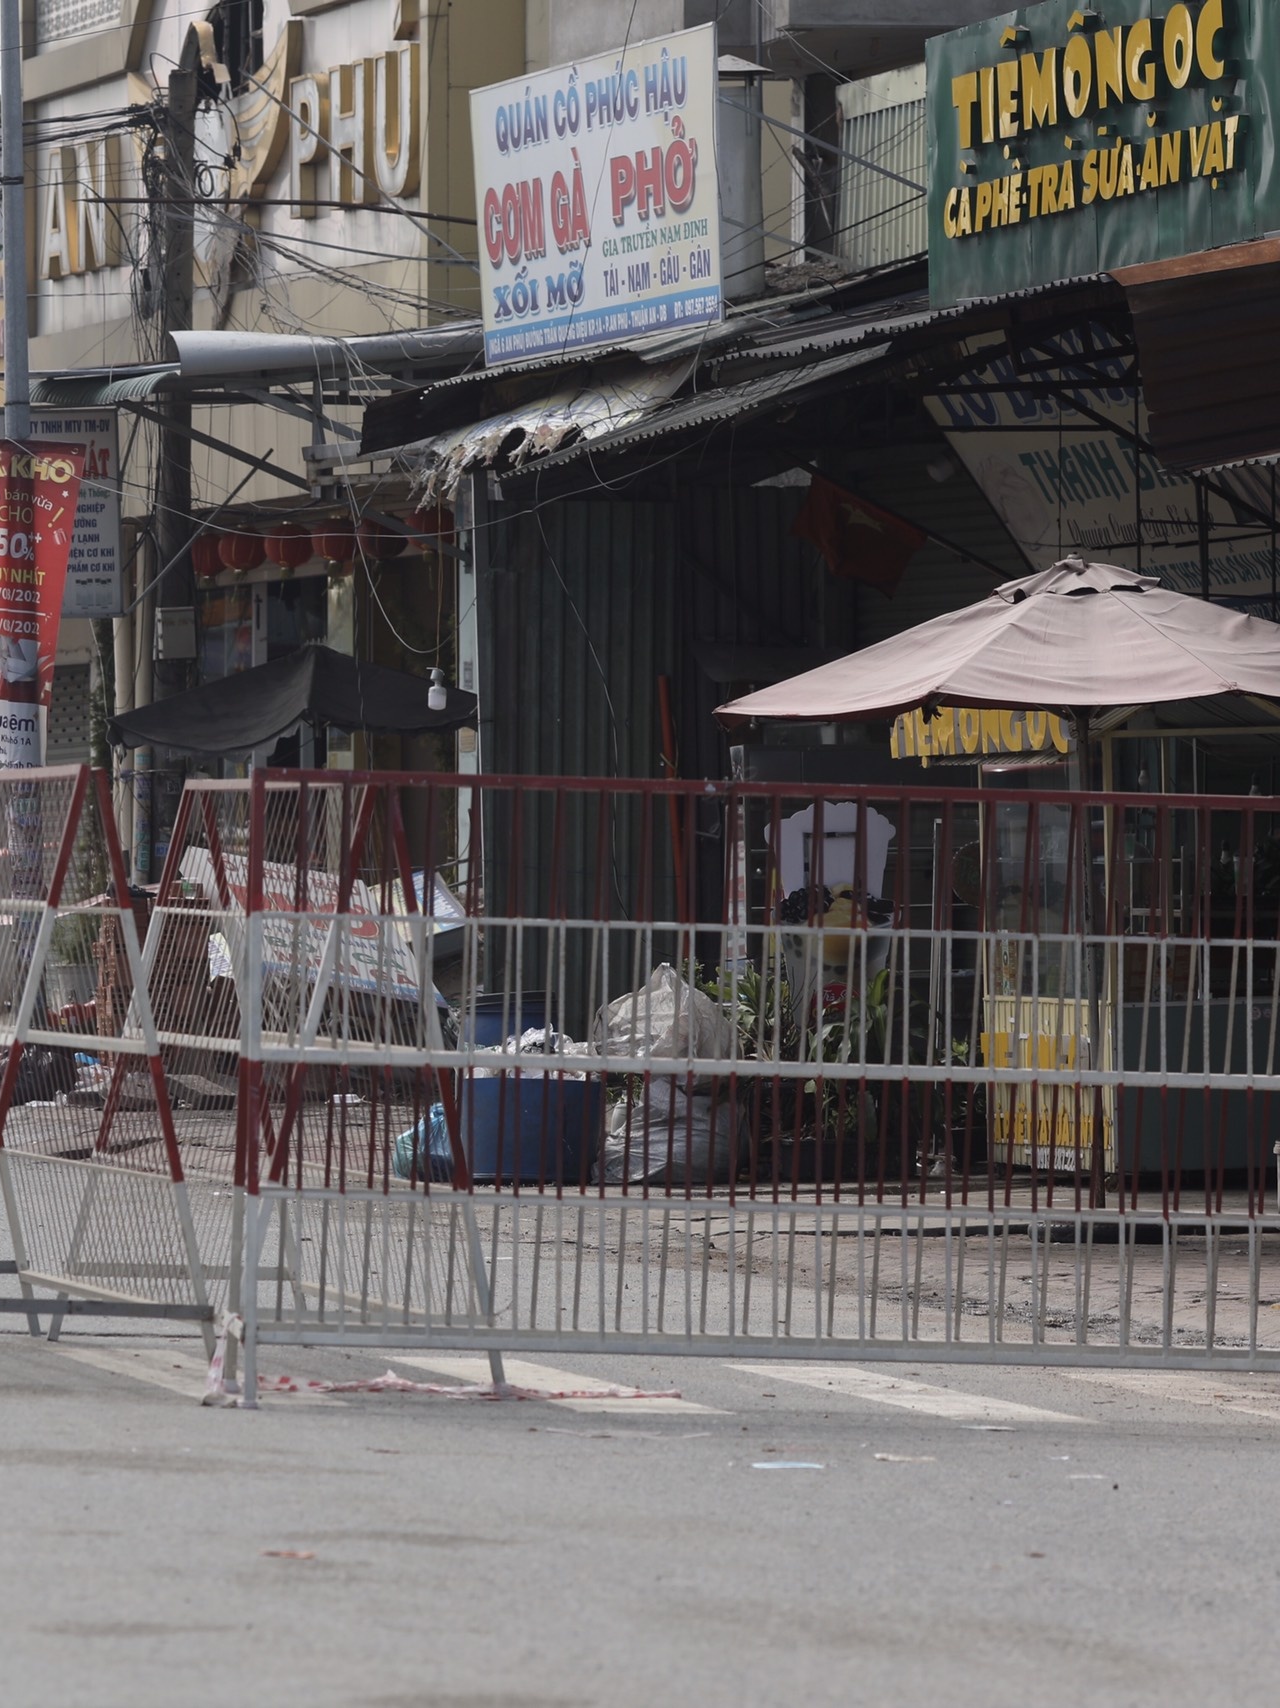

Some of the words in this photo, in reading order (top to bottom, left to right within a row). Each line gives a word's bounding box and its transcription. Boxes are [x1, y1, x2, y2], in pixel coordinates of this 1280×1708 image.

[495, 85, 549, 157] QUÁN
[585, 60, 639, 132] PHÚC
[644, 47, 687, 124] HẬU
[951, 25, 1058, 160] TIỆM
[1063, 9, 1156, 118] ÔNG
[610, 115, 698, 226] PHỞ
[943, 158, 972, 240] CÀ
[1189, 95, 1240, 190] VẶT
[40, 137, 118, 280] AN
[483, 177, 546, 268] CƠM
[550, 147, 591, 254] GÀ
[602, 239, 618, 258] GIA
[621, 223, 657, 254] TRUYỀN
[660, 224, 686, 243] NAM
[689, 218, 707, 245] ĐỊNH
[494, 266, 540, 323] XỐI
[546, 260, 585, 312] MỠ
[603, 263, 619, 297] TÁI
[628, 263, 650, 298] NẠM
[660, 246, 679, 286] GẦU
[689, 245, 711, 280] GÂN
[41, 420, 62, 433] TNHH
[65, 419, 82, 433] MTV
[4, 488, 29, 501] bán
[32, 495, 53, 511] vừa
[11, 455, 75, 483] KHO
[78, 533, 100, 545] LẠNH
